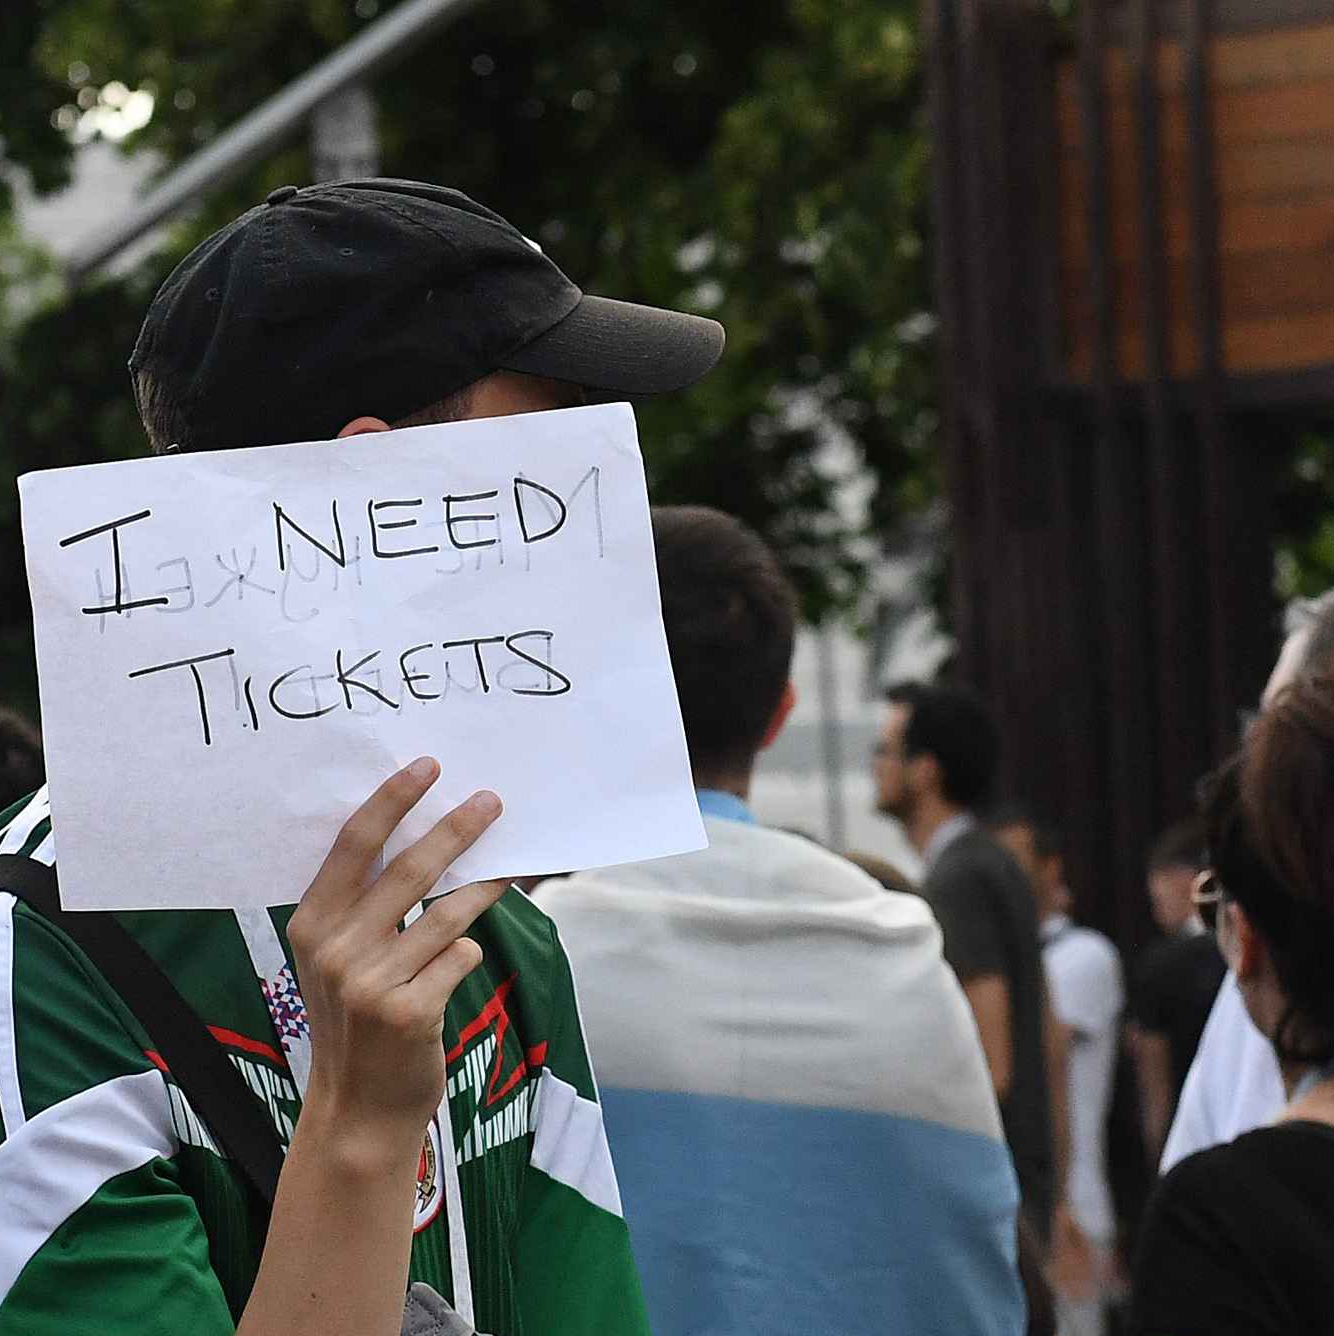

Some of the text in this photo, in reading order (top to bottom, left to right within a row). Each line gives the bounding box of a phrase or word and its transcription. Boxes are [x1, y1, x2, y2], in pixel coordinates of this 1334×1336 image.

[60, 475, 567, 616] I NEED
[128, 630, 573, 746] TICKETS
